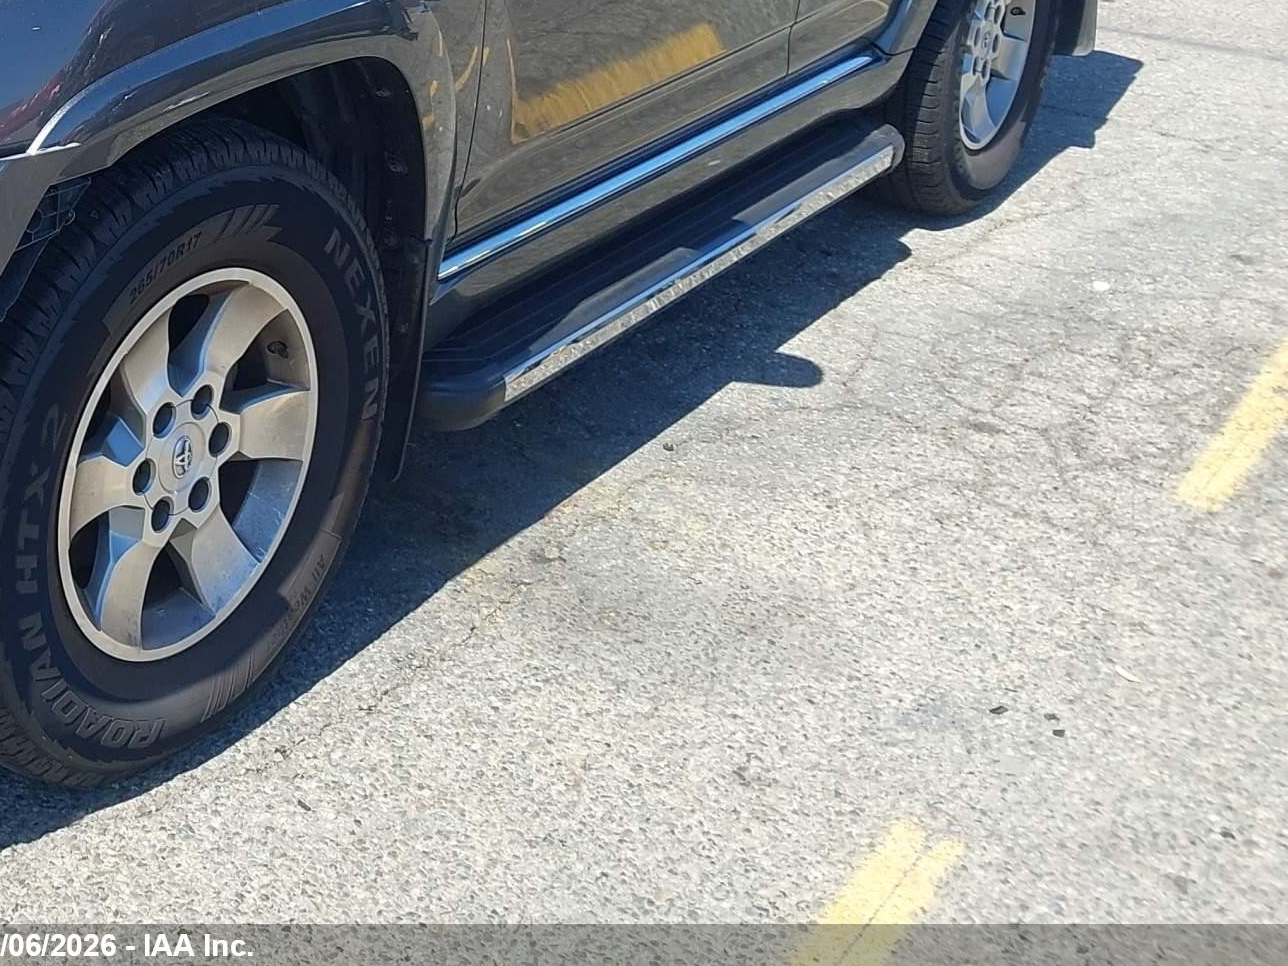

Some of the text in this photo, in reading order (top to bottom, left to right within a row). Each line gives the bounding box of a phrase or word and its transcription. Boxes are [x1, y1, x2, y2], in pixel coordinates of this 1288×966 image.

[129, 231, 202, 305] 265/70R17
[324, 227, 379, 420] NEXEN
[15, 462, 51, 594] HTX
[19, 611, 167, 748] ROADIAN
